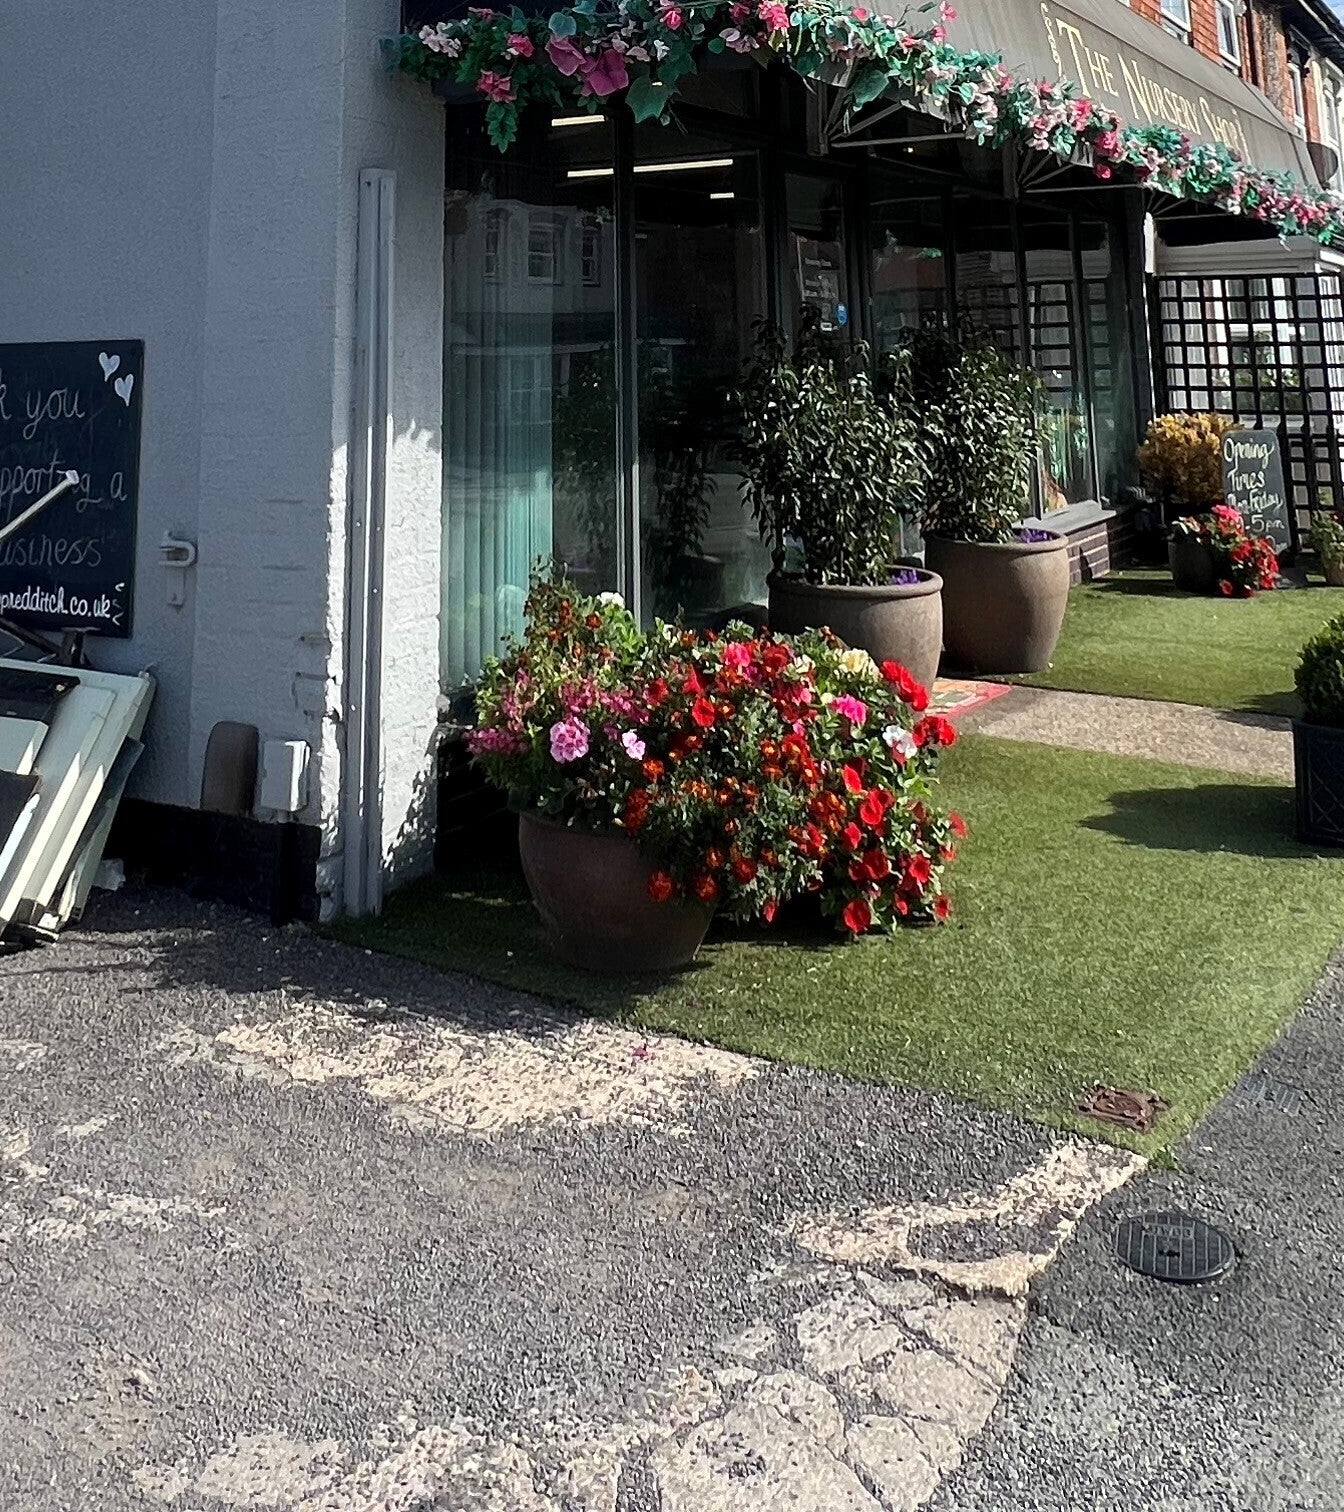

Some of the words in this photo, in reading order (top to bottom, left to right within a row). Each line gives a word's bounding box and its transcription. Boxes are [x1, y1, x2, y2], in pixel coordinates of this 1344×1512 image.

[22, 387, 86, 440] you
[1223, 437, 1275, 470] Opening
[110, 471, 128, 502] a
[1226, 467, 1266, 492] Times
